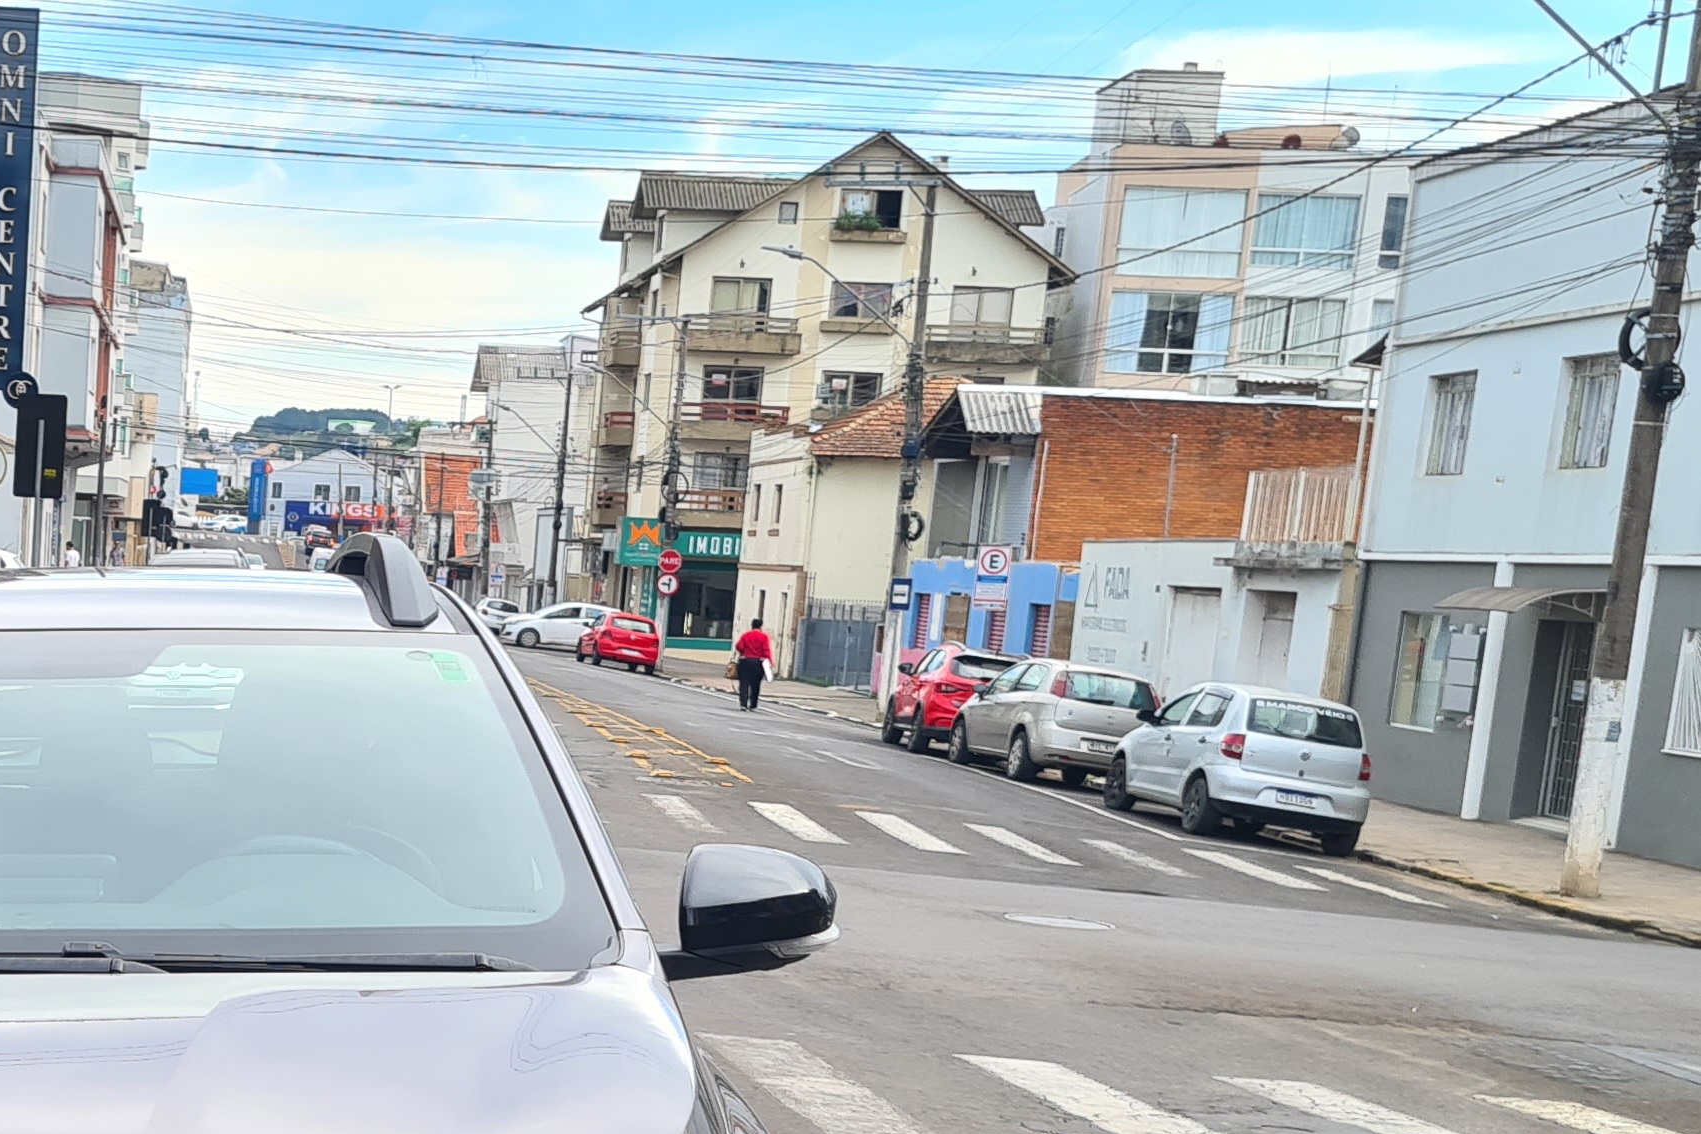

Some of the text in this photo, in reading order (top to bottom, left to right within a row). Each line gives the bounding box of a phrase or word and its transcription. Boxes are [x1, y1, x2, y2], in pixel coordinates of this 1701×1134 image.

[0, 29, 27, 157] OMNI
[660, 557, 680, 565] PARE
[989, 554, 1000, 569] E
